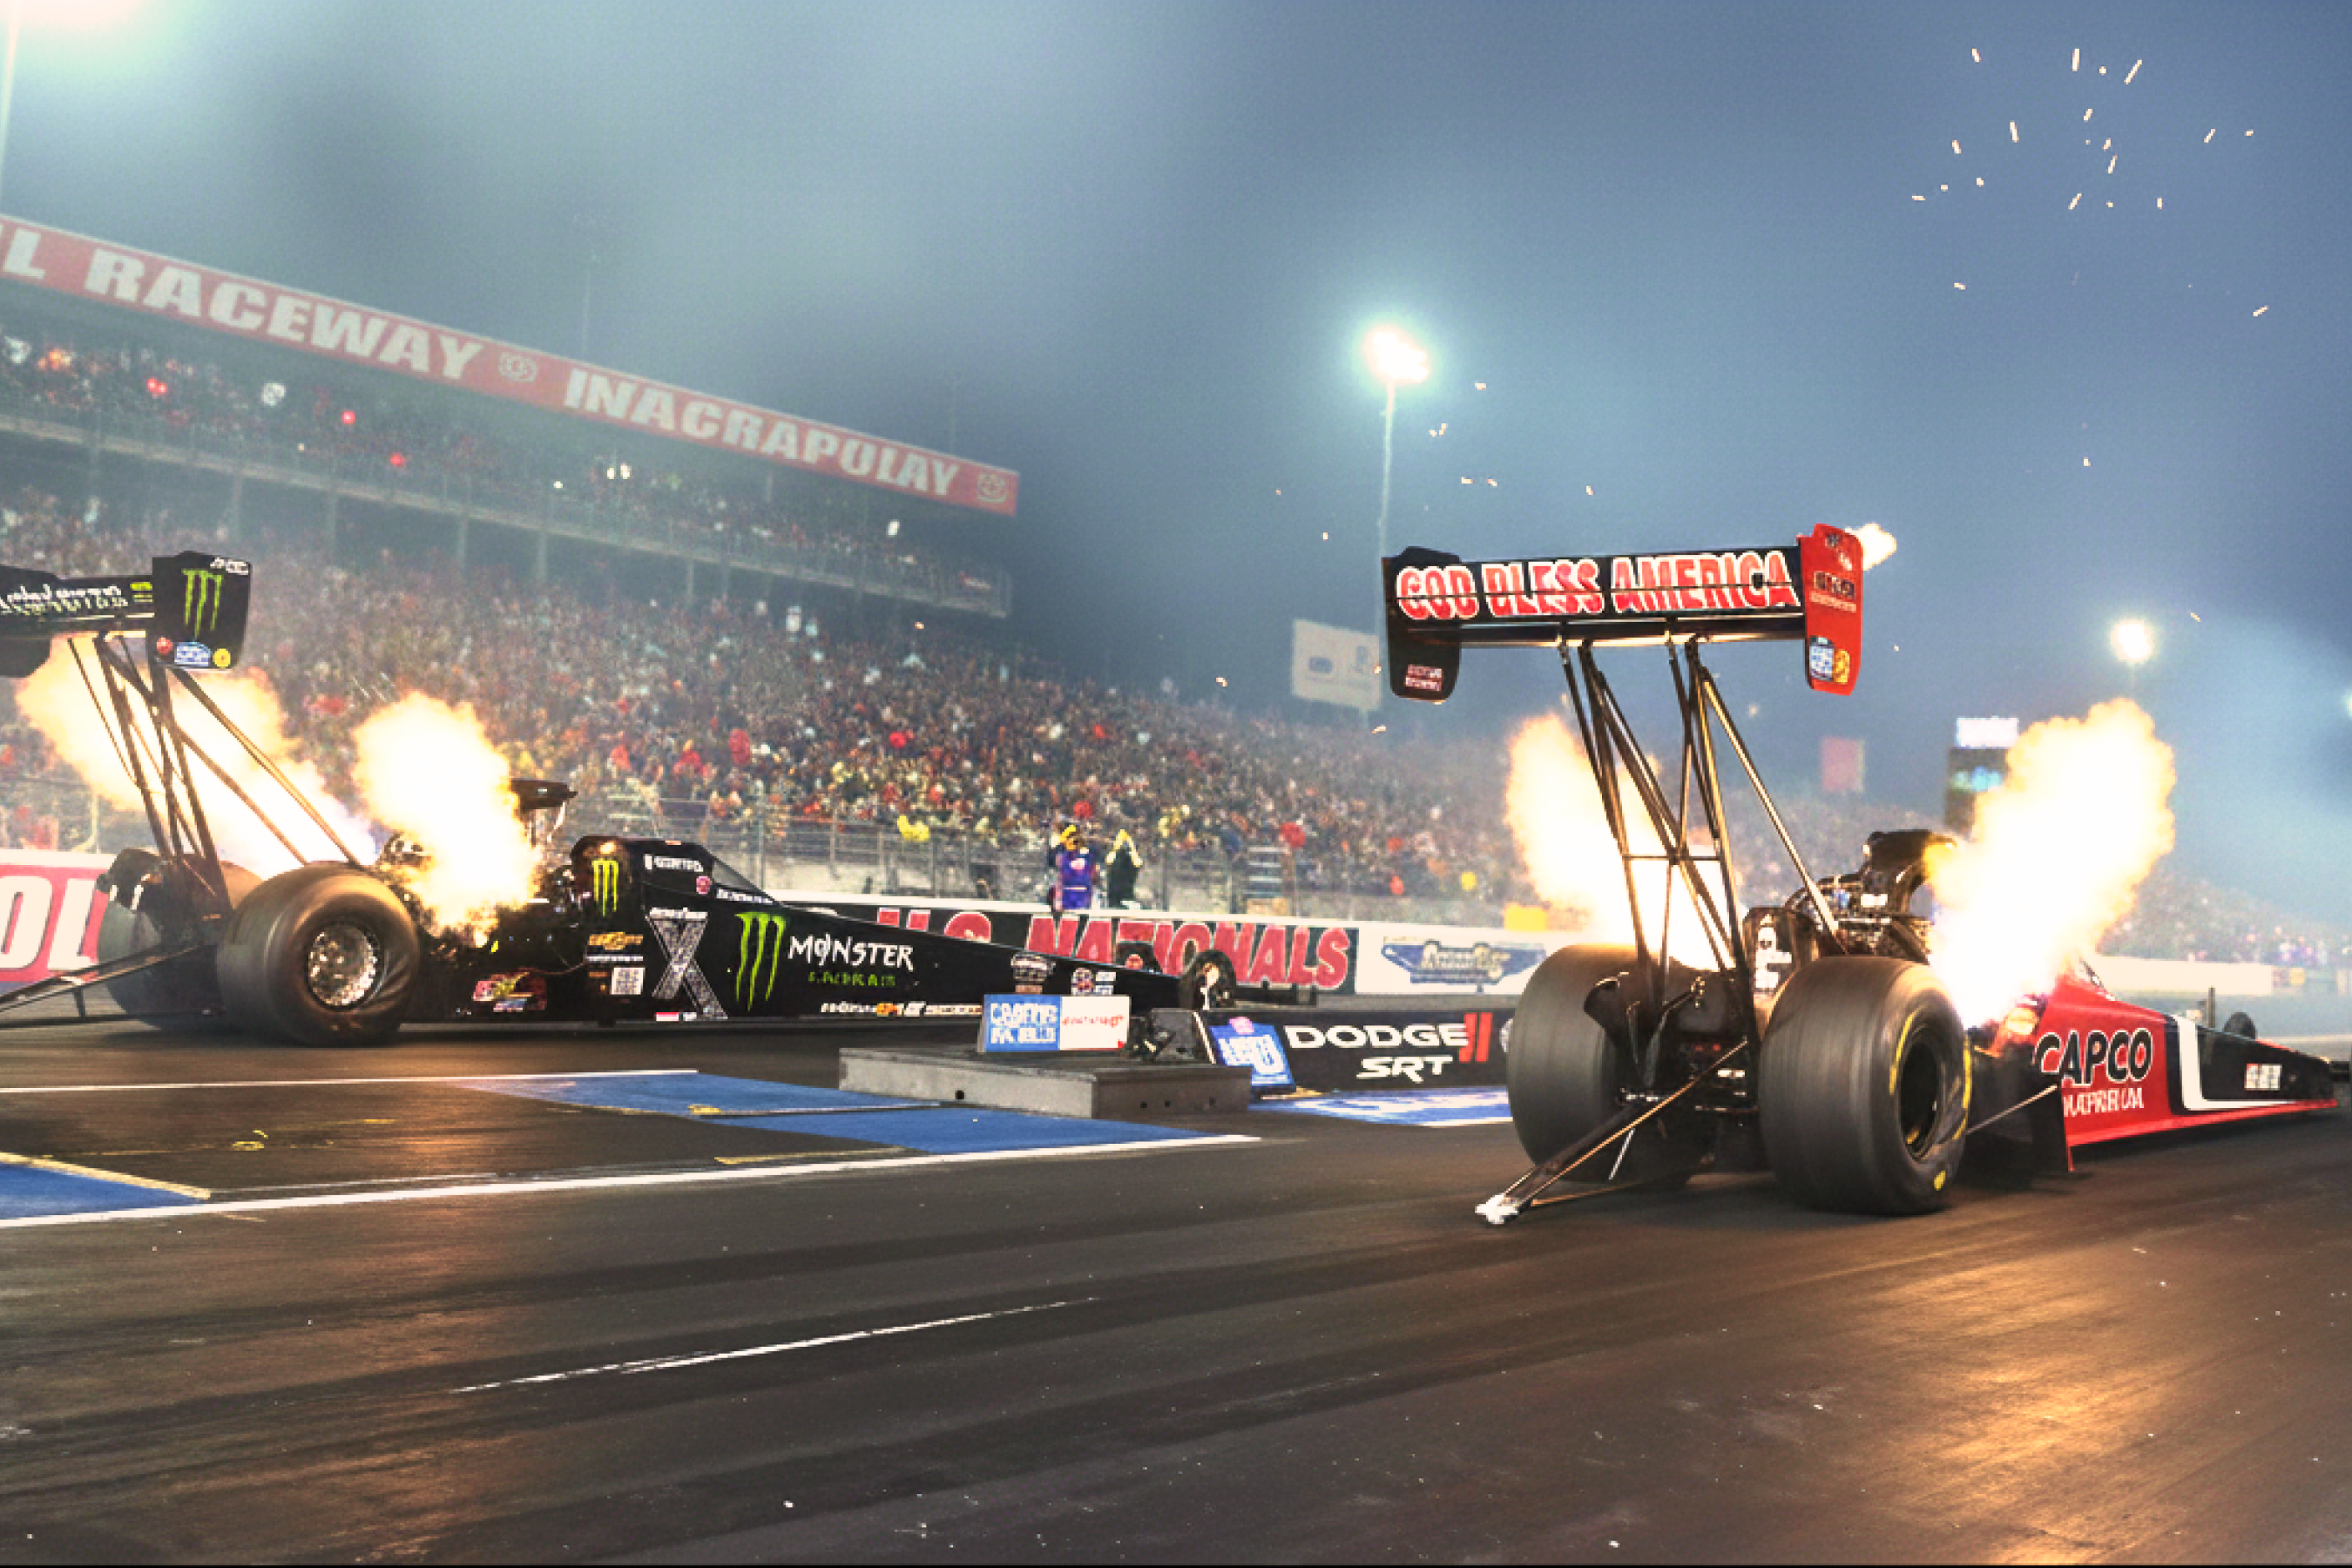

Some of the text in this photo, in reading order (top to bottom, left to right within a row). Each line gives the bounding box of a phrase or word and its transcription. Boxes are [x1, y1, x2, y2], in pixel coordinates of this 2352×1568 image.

[0, 224, 44, 279] L
[84, 248, 484, 380] RACEWAY
[1396, 565, 1479, 620] GOD
[1610, 550, 1801, 613] AMERICA
[787, 932, 914, 971] MONSTER
[1283, 1024, 1470, 1048] DODGE
[2032, 1028, 2153, 1086] CAPCO
[1356, 1055, 1453, 1083] SRT
